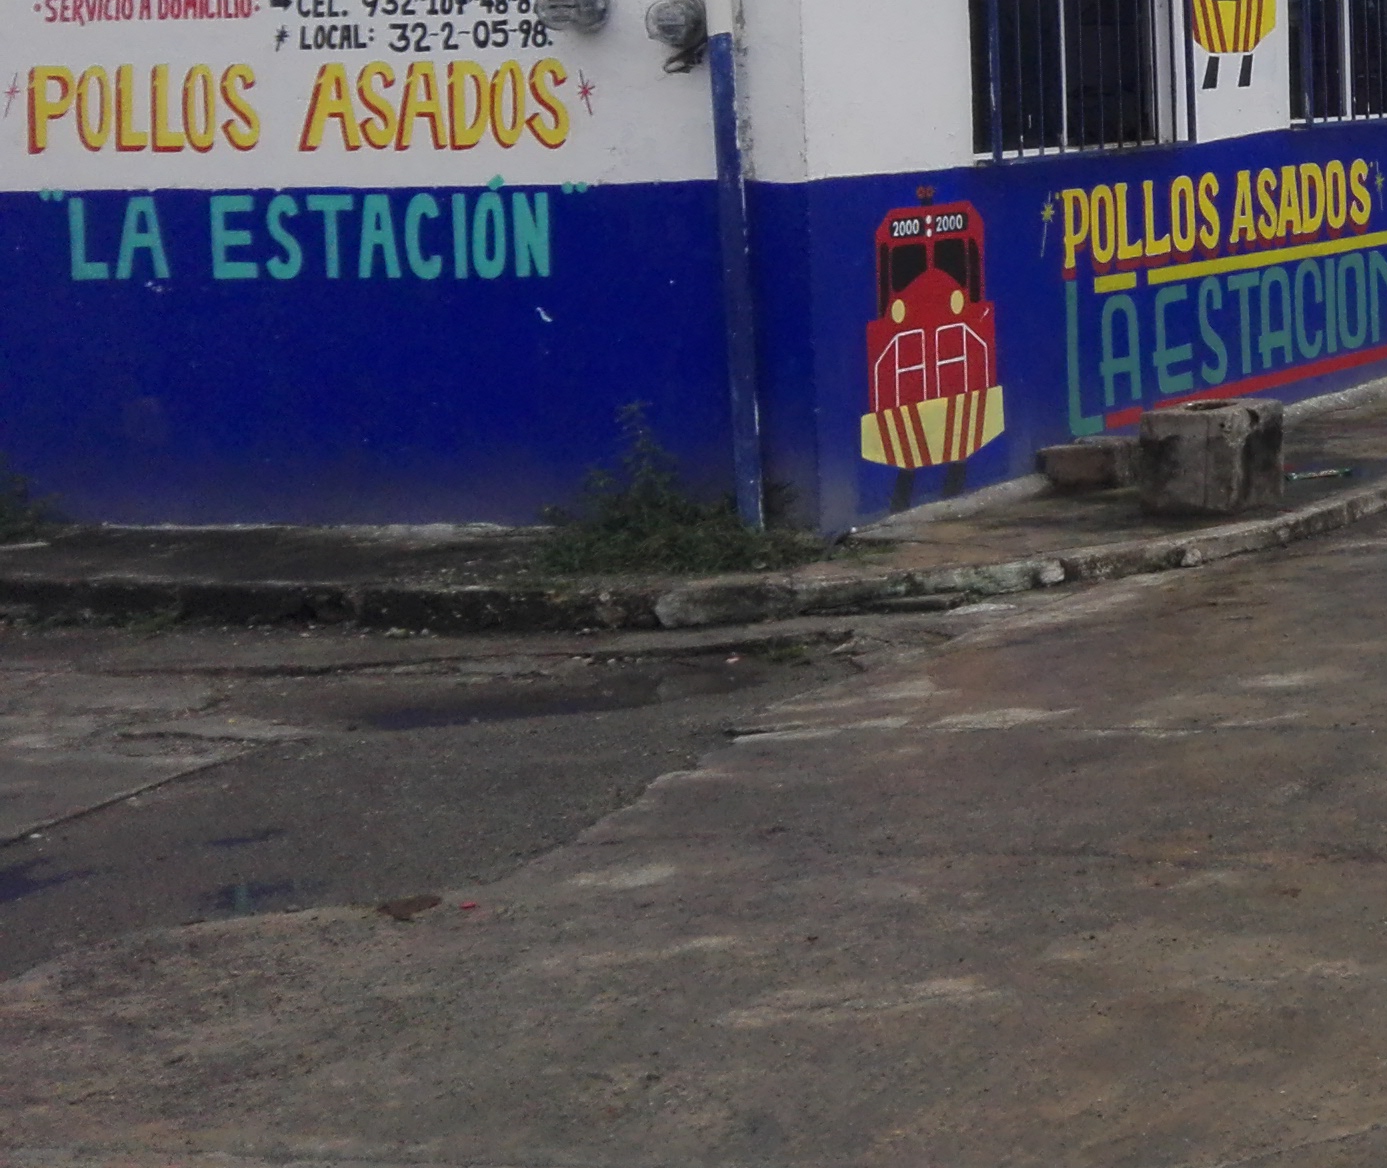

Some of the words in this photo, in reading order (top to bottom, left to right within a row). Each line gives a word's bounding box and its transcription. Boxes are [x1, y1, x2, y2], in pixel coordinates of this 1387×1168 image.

[300, 24, 375, 50] LOCAL:
[27, 63, 261, 154] POLLOS
[299, 57, 571, 153] ASADOS
[892, 219, 920, 237] 2000
[936, 214, 963, 232] 2000
[1065, 280, 1142, 437] LA
